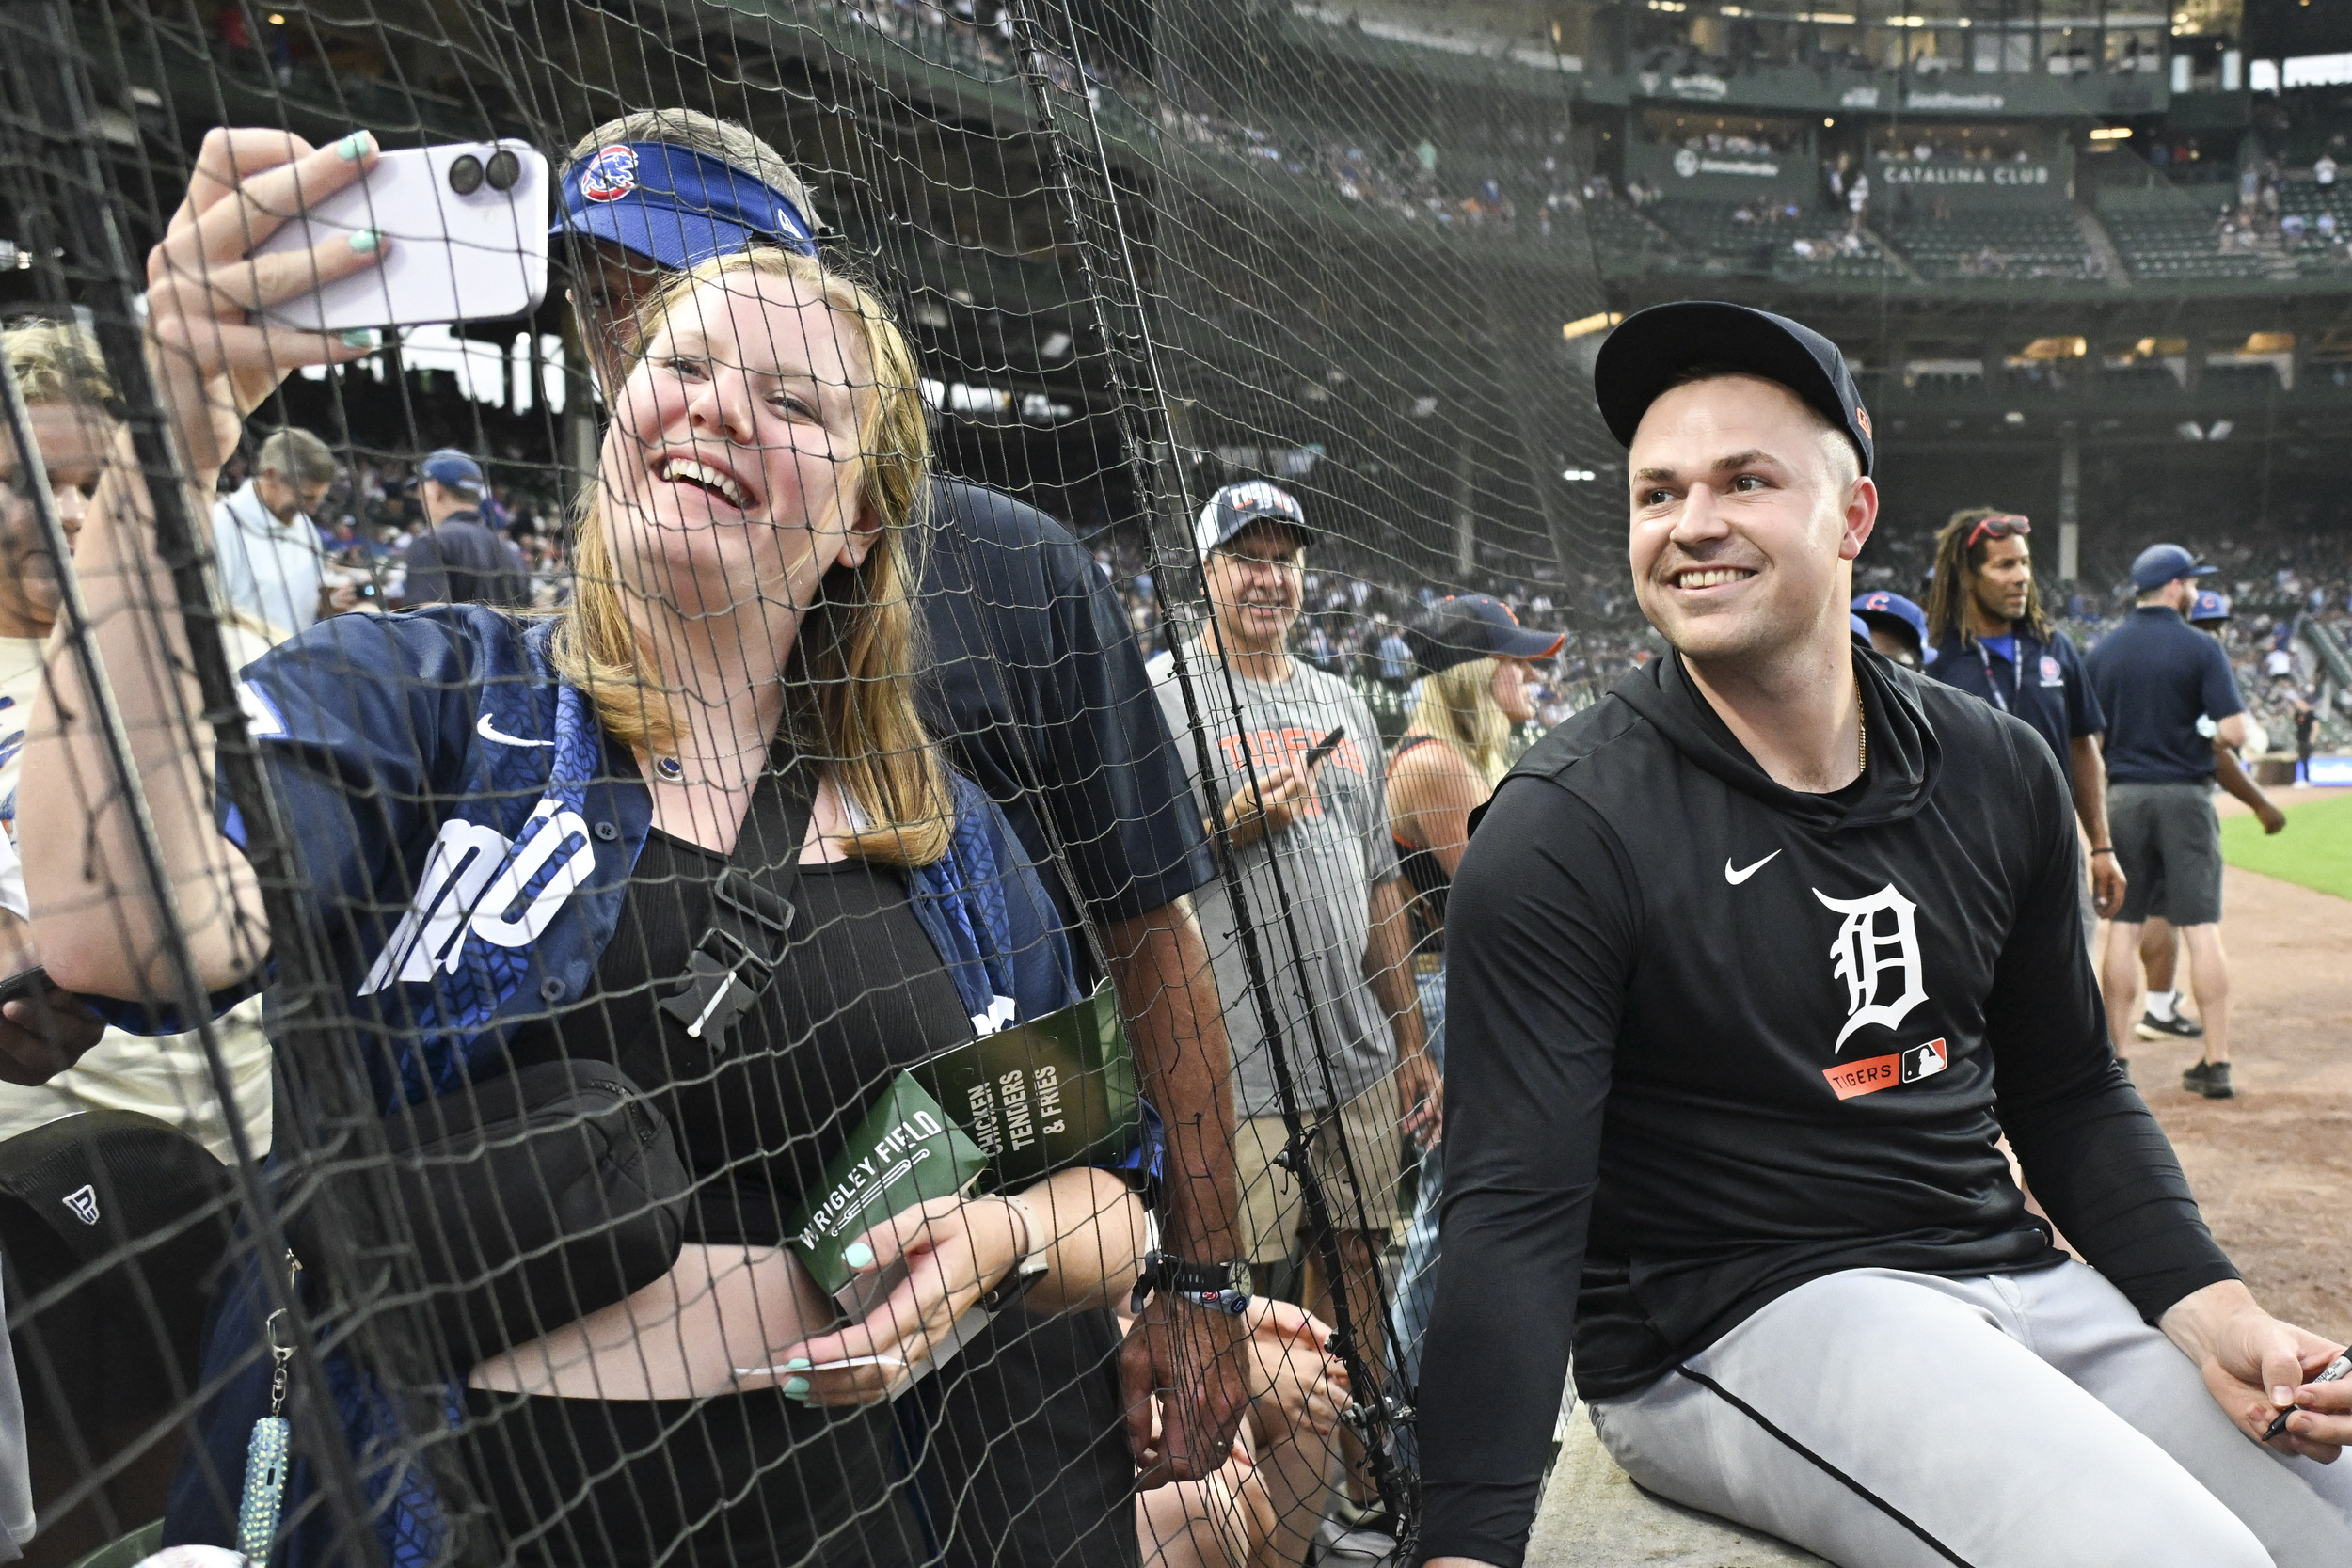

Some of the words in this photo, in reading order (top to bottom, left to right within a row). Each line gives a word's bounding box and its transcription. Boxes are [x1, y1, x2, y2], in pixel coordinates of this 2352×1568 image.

[1883, 165, 1987, 184] CATALINA
[1993, 165, 2049, 185] CLUB
[1811, 882, 1930, 1055] D
[1034, 1065, 1062, 1118] FRIES
[1832, 1064, 1892, 1089] TIGERS
[999, 1069, 1035, 1152] TENDERS
[1042, 1118, 1066, 1135] &
[799, 1156, 876, 1251] WRIGLEY
[873, 1110, 942, 1164] FIELD
